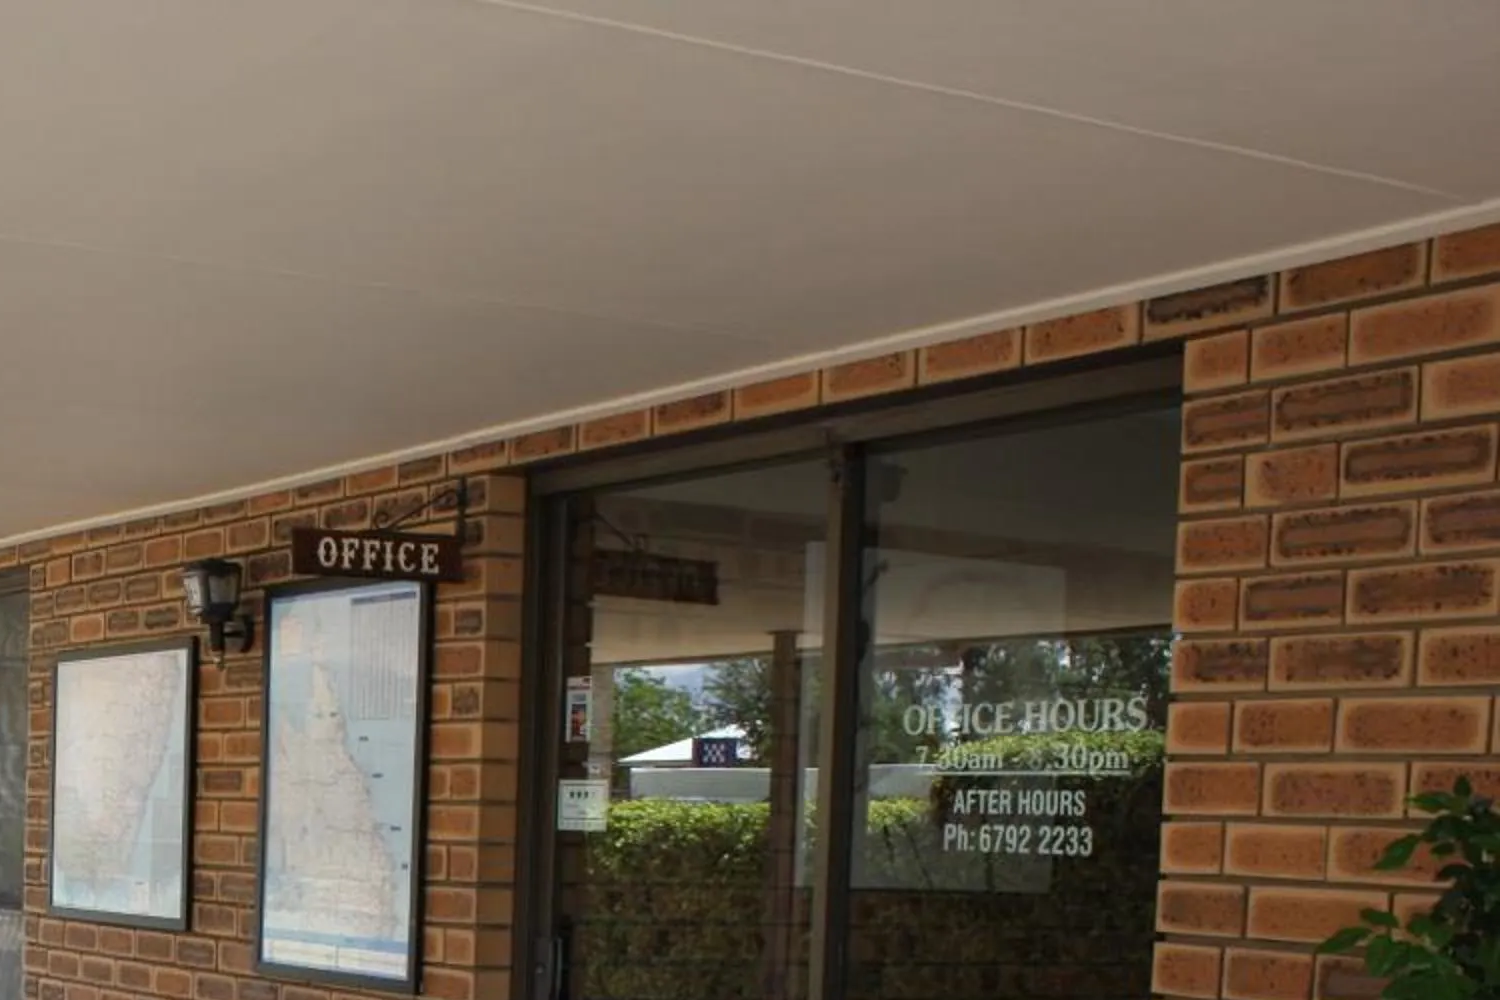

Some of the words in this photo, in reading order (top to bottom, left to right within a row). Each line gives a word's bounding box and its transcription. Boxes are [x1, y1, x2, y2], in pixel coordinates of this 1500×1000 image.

[317, 536, 440, 575] OFFICE
[902, 701, 1015, 736] OFICE
[1023, 698, 1149, 734] HOURS
[915, 745, 1003, 770] 730am
[953, 789, 1012, 816] AFTER
[1017, 789, 1086, 817] HOURS
[943, 823, 976, 851] Ph:
[979, 825, 1029, 854] 6792
[1038, 826, 1093, 857] 2233
